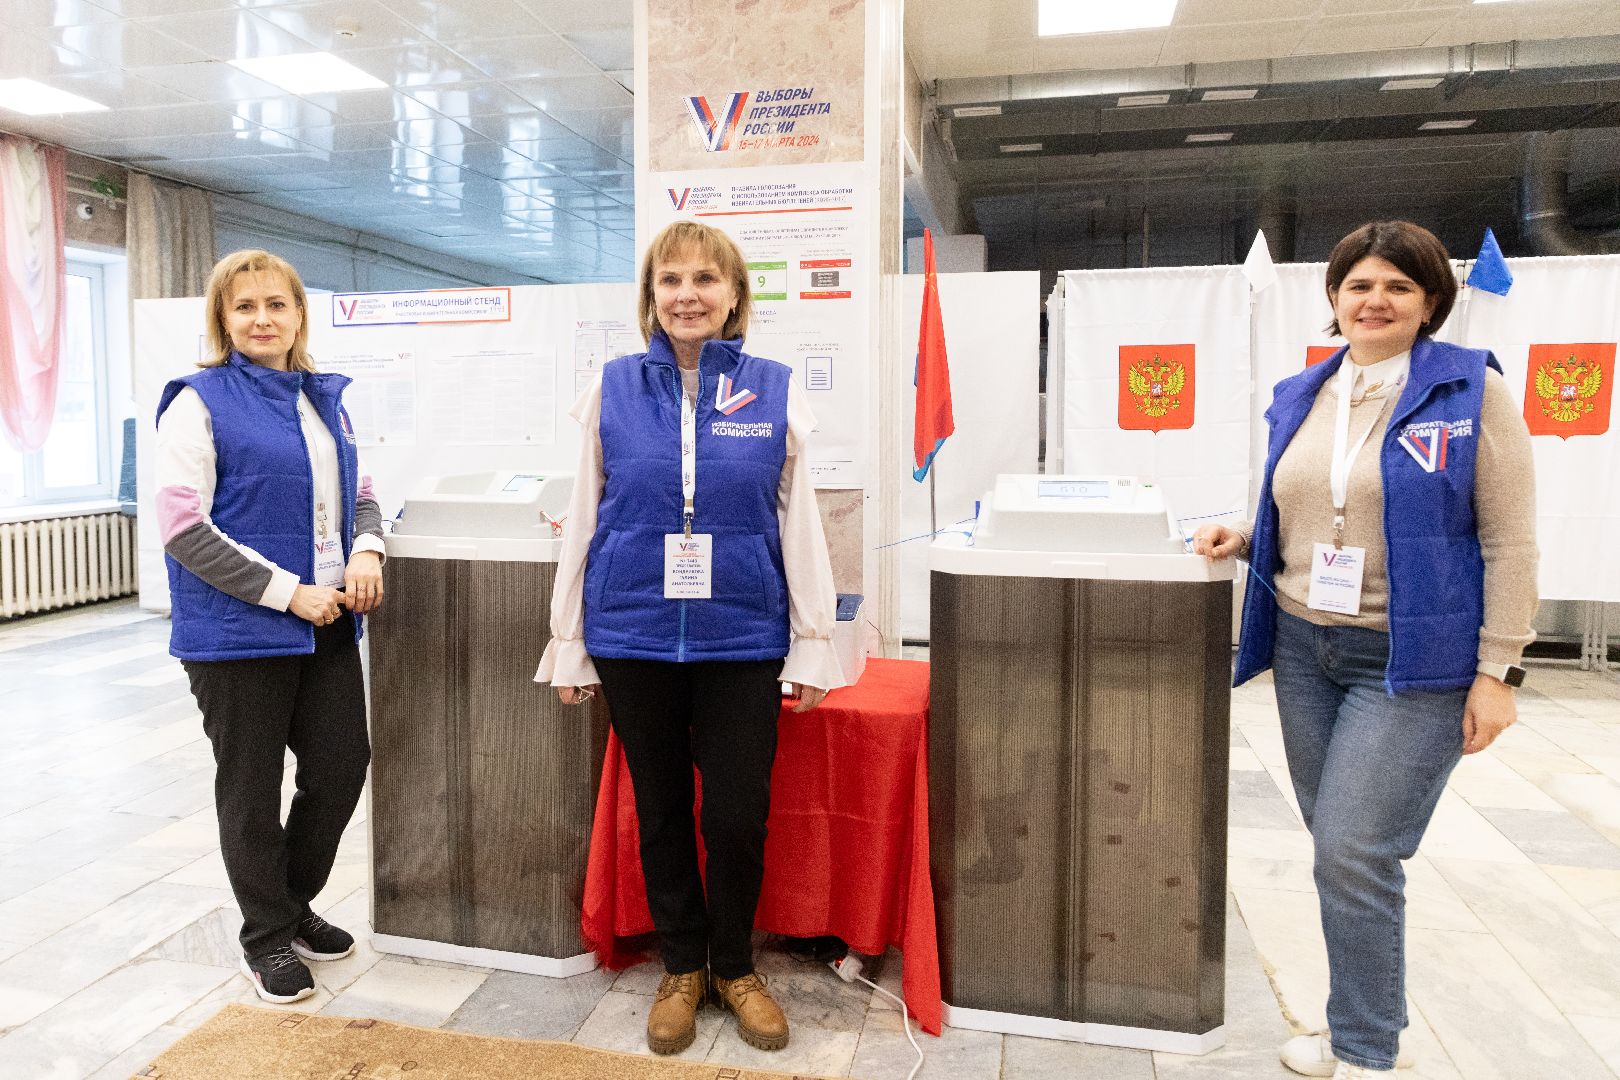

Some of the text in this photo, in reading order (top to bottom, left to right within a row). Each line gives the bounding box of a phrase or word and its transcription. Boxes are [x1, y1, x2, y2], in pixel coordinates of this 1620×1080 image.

[755, 87, 815, 103] ВЫБОРЫ
[749, 102, 831, 119] ПРЕЗИДЕНТА
[743, 121, 796, 136] РОСИИ
[796, 134, 820, 147] 2024
[757, 275, 766, 288] 9
[392, 296, 501, 308] ИНФОРМАЦИОННЫЙ СТЕНД
[711, 421, 773, 430] ИЗБИРАТЕЛЬНАЯ
[1404, 418, 1473, 430] ЗБИРАТЕЬНАЯ
[711, 427, 773, 438] КОМИССИЯ
